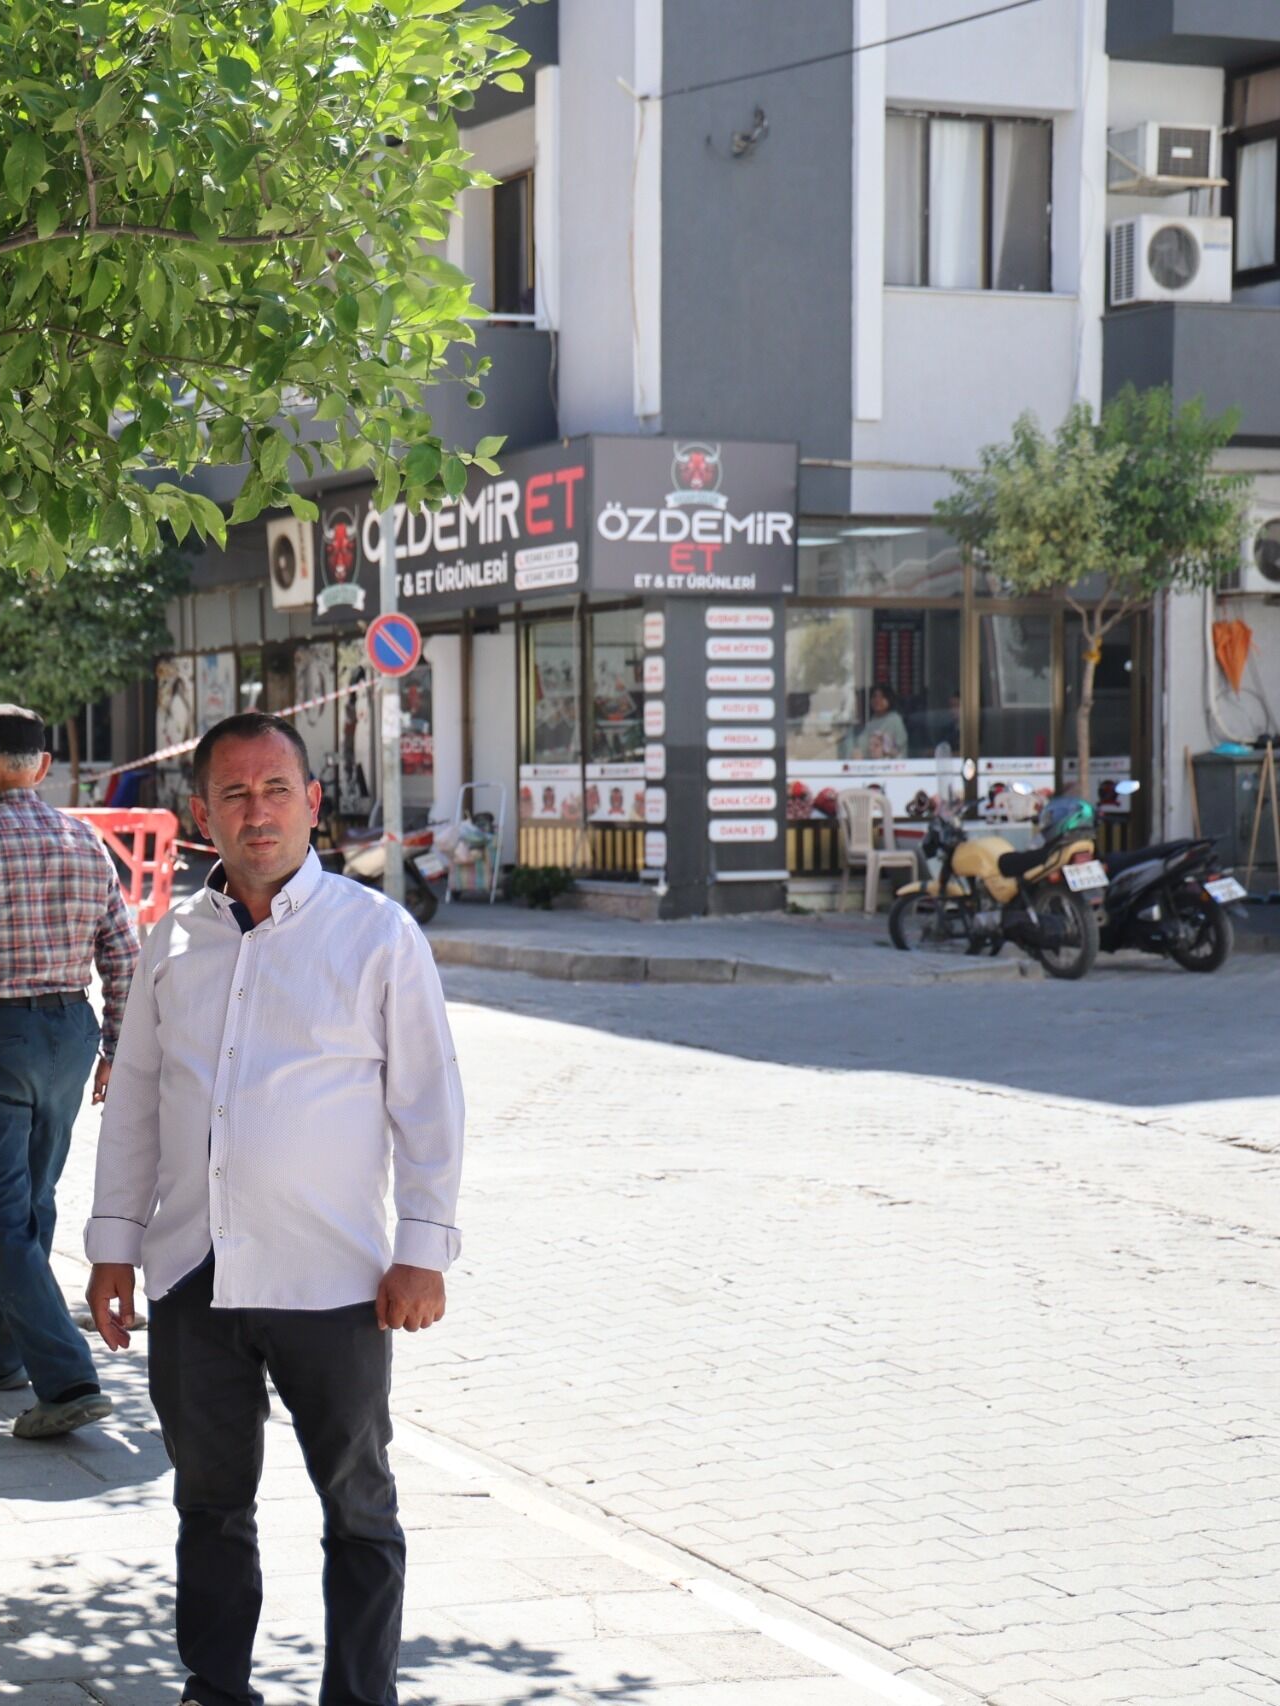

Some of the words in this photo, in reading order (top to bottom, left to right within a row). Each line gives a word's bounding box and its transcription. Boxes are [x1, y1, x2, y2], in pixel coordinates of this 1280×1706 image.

[525, 466, 585, 536] ET
[416, 569, 433, 596] ET
[435, 552, 508, 593] ÜRÜNLERİ
[670, 542, 722, 574] ET
[634, 573, 650, 588] ET
[654, 574, 665, 588] &
[667, 574, 684, 589] ET
[687, 571, 756, 591] ÜRÜNLERİ
